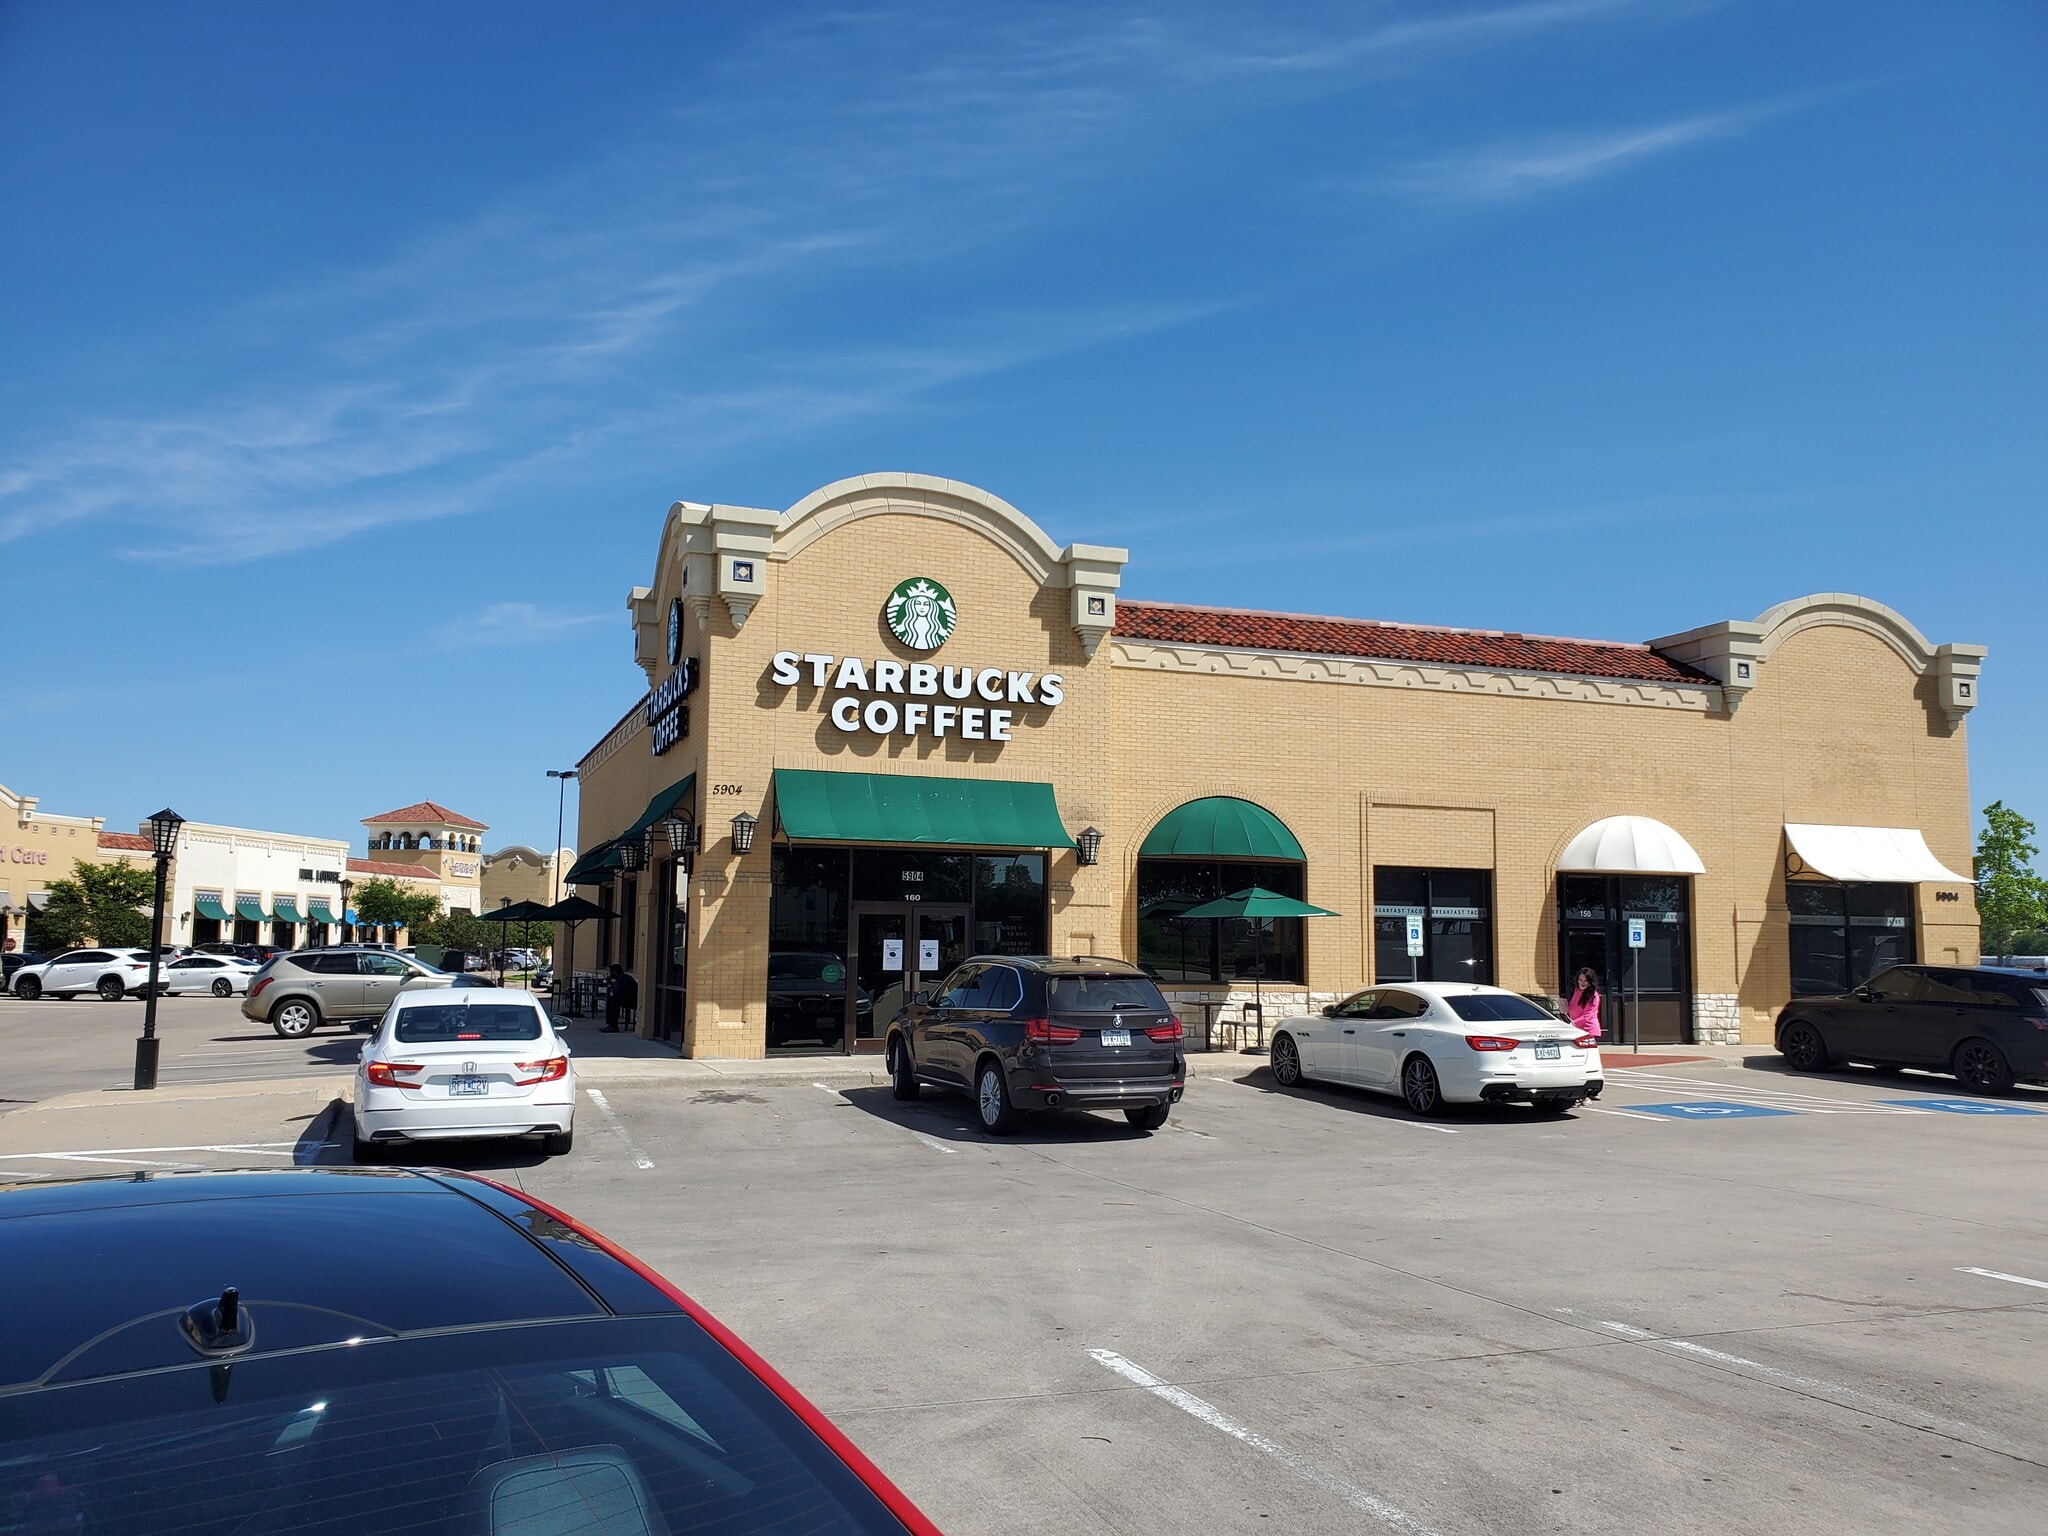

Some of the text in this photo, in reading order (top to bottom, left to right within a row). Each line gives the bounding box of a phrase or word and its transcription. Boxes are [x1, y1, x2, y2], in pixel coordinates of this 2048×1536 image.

[771, 651, 1065, 706] STARBUCKS
[646, 657, 690, 723] STARBUCKS
[831, 697, 1012, 741] COFFEE
[652, 705, 680, 756] COFFEE
[712, 785, 743, 795] 5904
[11, 845, 48, 865] Care
[903, 871, 923, 881] 5904
[1935, 892, 1959, 902] 5904
[1580, 910, 1592, 918] 150
